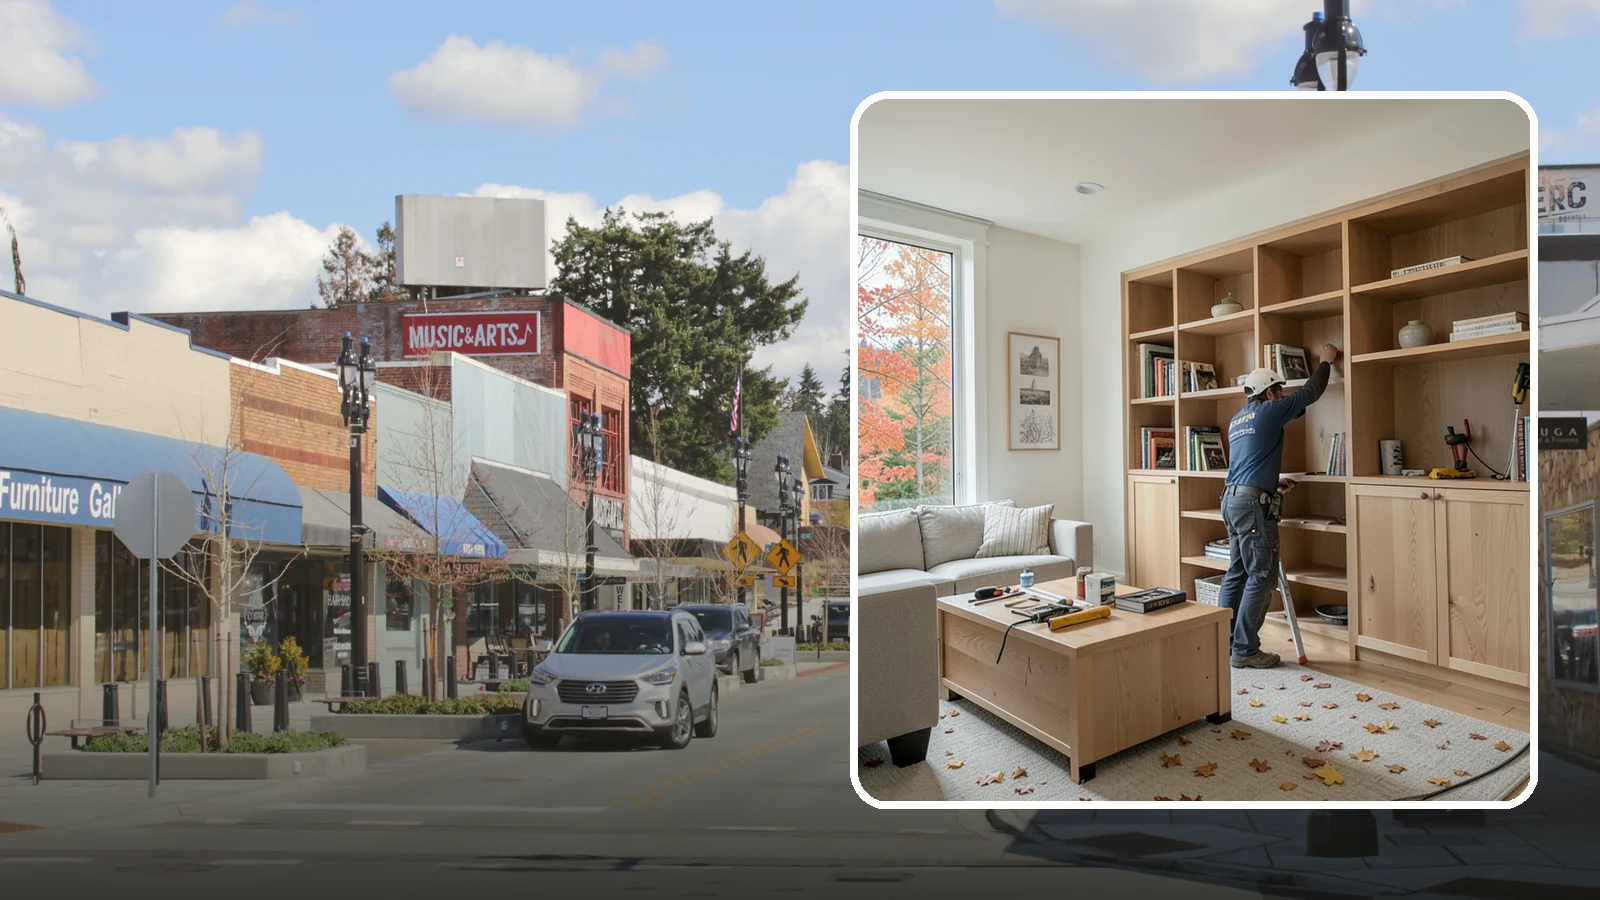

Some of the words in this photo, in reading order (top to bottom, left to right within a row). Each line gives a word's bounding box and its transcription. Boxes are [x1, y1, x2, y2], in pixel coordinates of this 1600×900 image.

[408, 322, 520, 349] MUSIC&ARTS
[0, 471, 79, 515] Furniture
[89, 482, 122, 519] Gal
[453, 563, 479, 574] SUSHI
